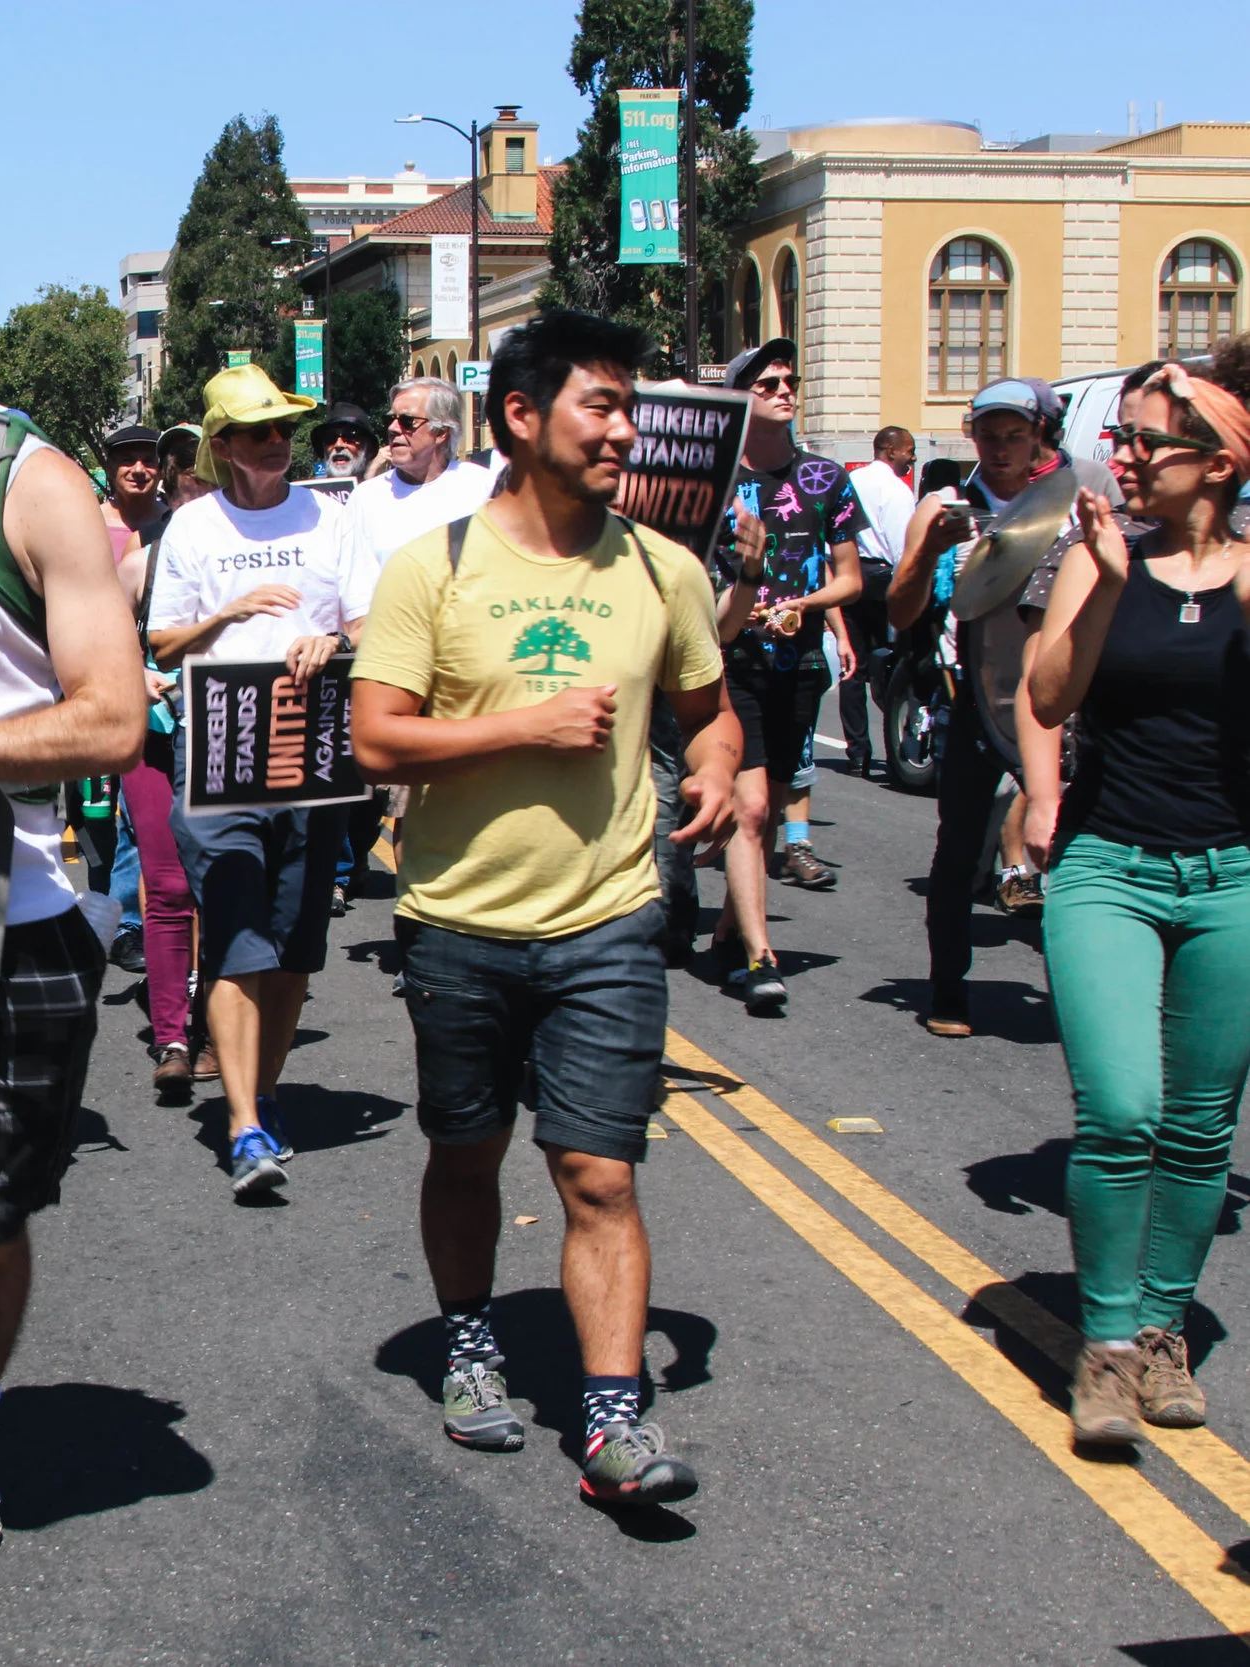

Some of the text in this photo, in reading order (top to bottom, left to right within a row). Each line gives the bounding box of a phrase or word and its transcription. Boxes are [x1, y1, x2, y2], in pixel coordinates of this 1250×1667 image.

[623, 110, 676, 130] 511.org
[626, 140, 640, 149] FREE
[620, 155, 678, 175] Information
[622, 149, 659, 163] Parking
[324, 217, 352, 225] YOUNG
[297, 330, 322, 340] 511.org
[463, 367, 478, 386] P
[629, 435, 716, 470] STANDS
[217, 545, 306, 573] resist
[489, 596, 613, 618] OAKLAND
[205, 676, 228, 795] BERKELEY
[234, 685, 258, 784] STANDS
[265, 675, 309, 790] UNITED
[314, 676, 338, 783] AGAINST
